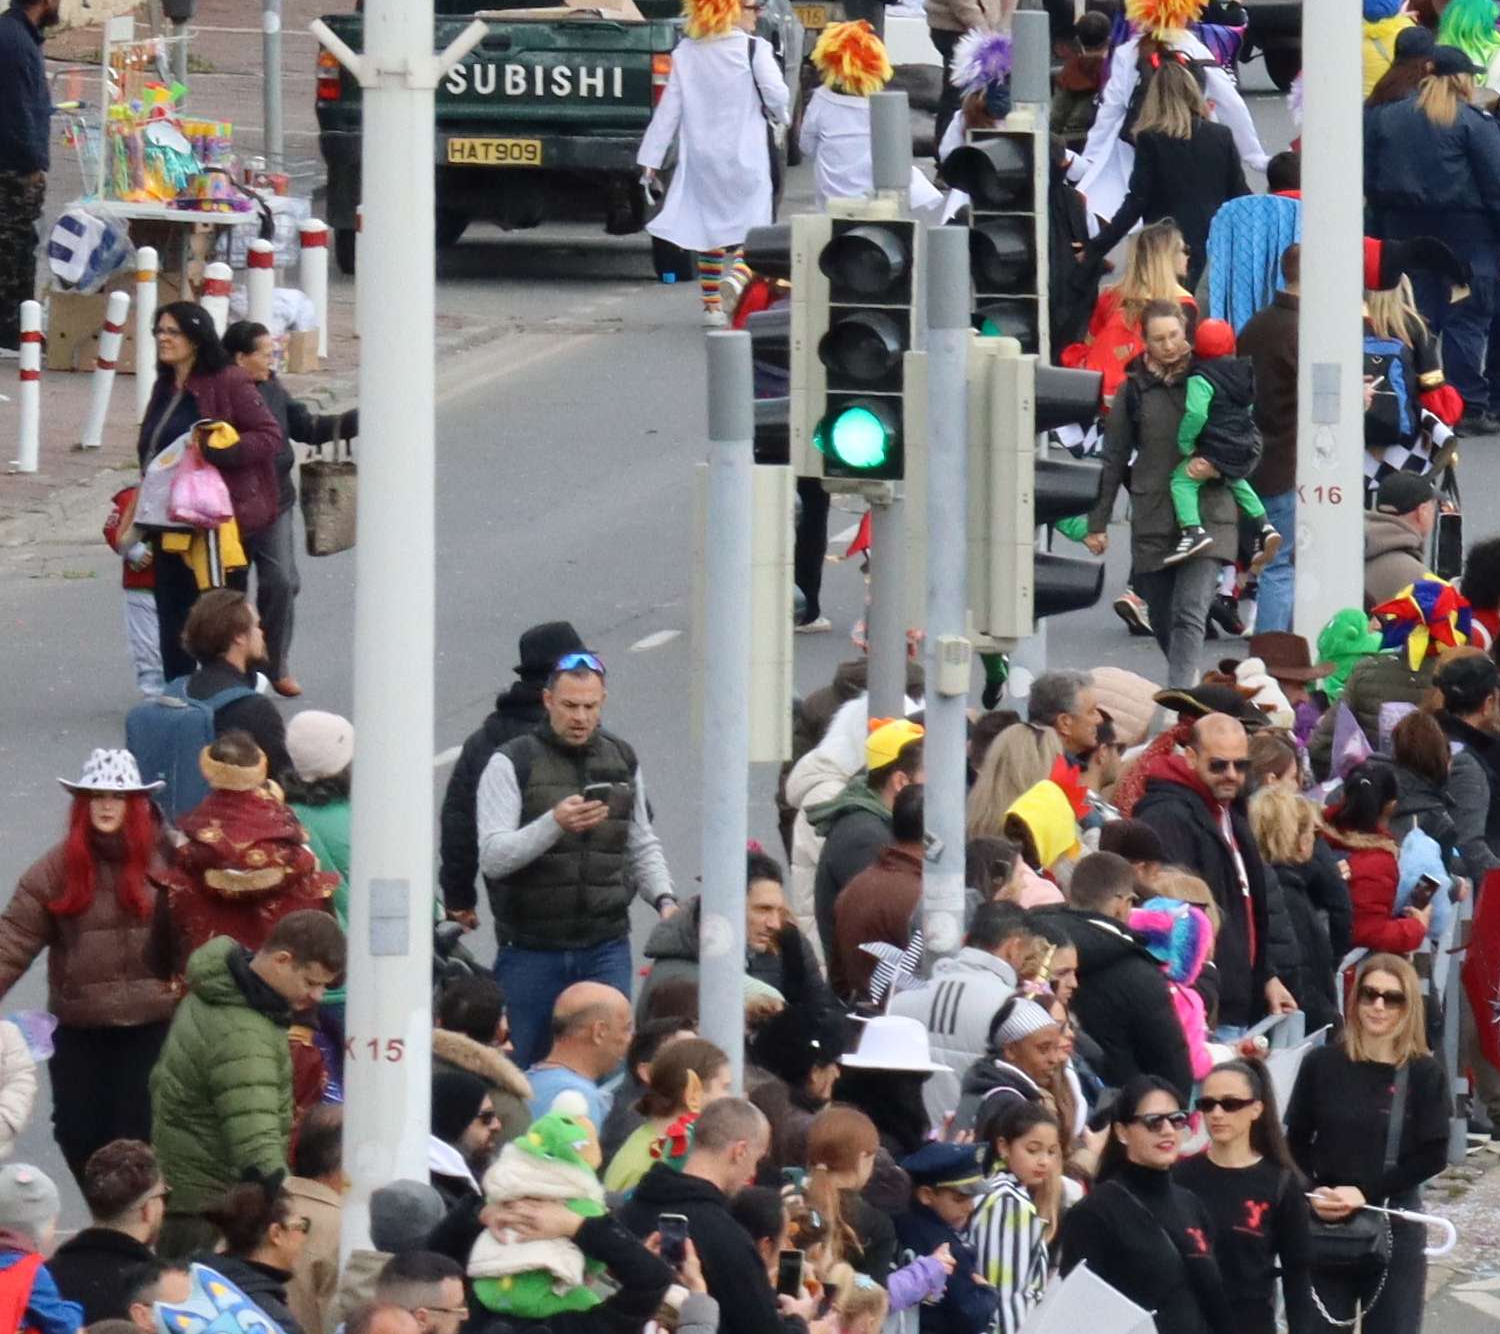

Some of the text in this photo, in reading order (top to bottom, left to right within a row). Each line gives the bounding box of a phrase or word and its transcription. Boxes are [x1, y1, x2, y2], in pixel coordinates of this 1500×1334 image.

[450, 142, 538, 161] HAT909
[1313, 484, 1343, 505] 16
[367, 1037, 405, 1062] 15
